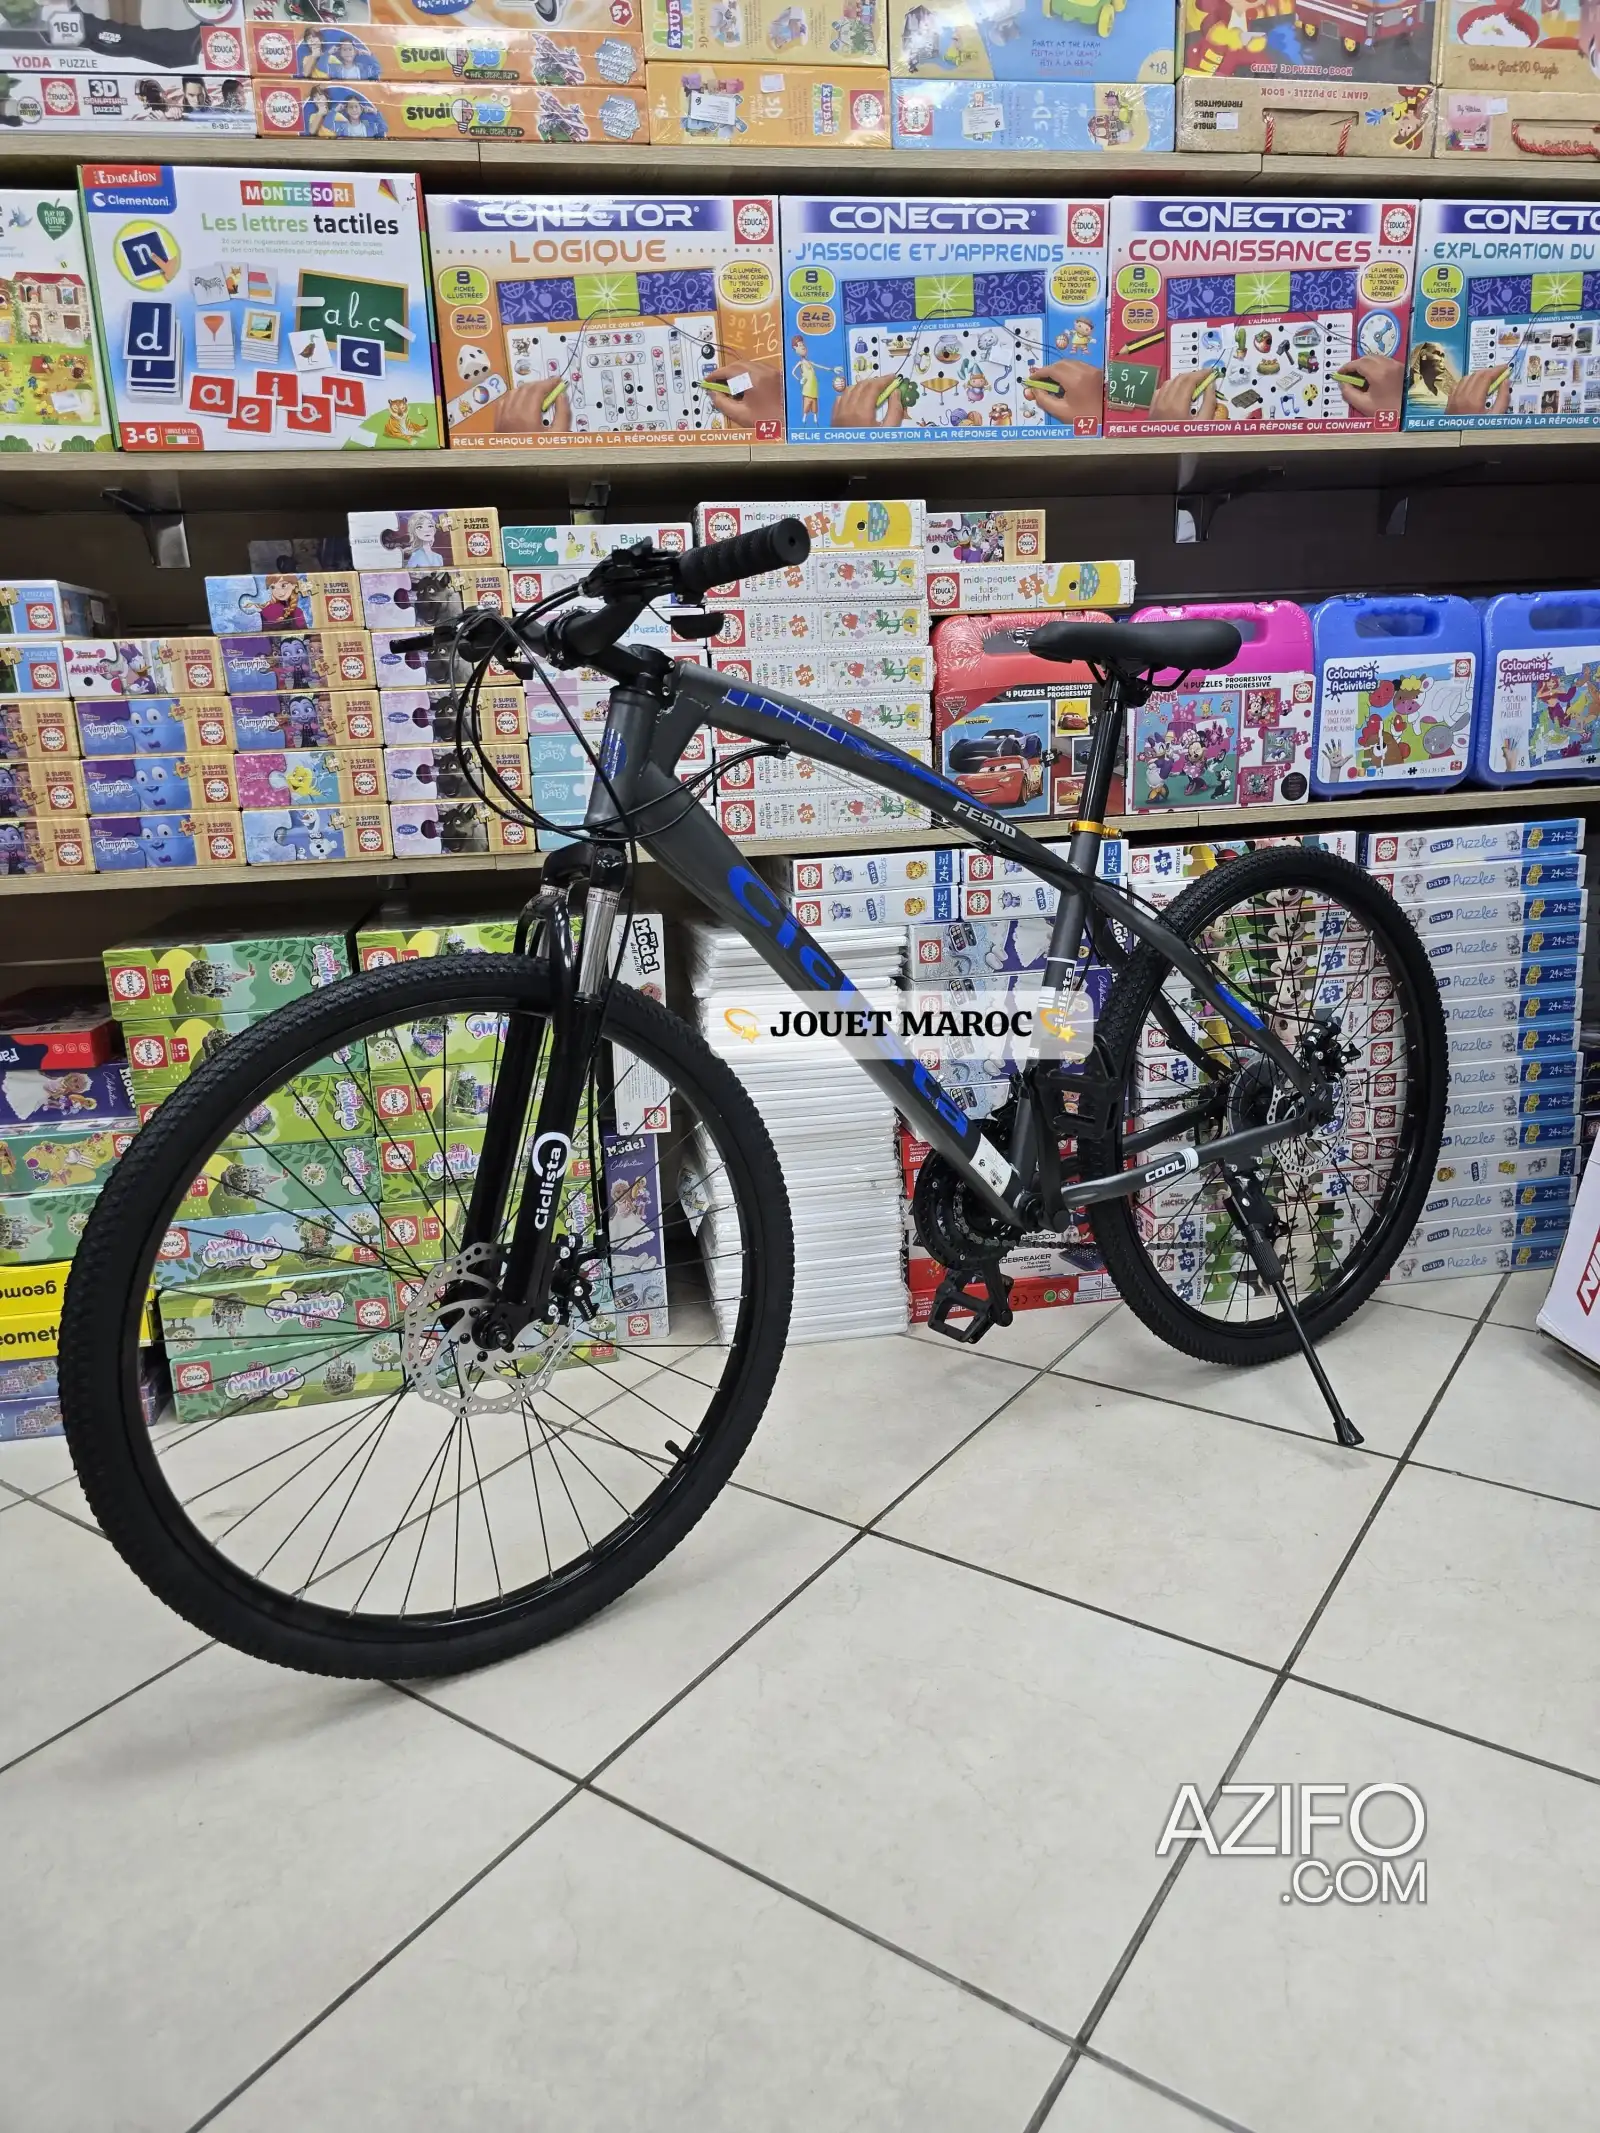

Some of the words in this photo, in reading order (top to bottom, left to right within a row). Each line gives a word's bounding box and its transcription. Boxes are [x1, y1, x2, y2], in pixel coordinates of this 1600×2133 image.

[612, 5, 631, 21] 5+
[53, 21, 79, 33] 160
[12, 55, 51, 69] YODA
[59, 58, 99, 69] PUZZLE
[1251, 63, 1278, 73] GIANT
[1280, 64, 1291, 74] 3D
[1292, 65, 1323, 75] PUZZLE
[1329, 66, 1353, 76] BOOK
[90, 79, 118, 98] 3D
[1260, 87, 1285, 97] BOOK
[1293, 89, 1325, 98] PUZZLE
[1326, 90, 1337, 98] 3D
[1341, 91, 1369, 100] GIANT
[93, 105, 121, 115] puzzle
[245, 185, 350, 202] MONTESSORI
[107, 195, 170, 207] Clementoni
[45, 216, 67, 226] FUTURE
[201, 213, 238, 231] Les
[242, 213, 309, 233] lettres
[313, 213, 399, 235] tactiles
[478, 203, 695, 233] CONECTOR
[743, 218, 765, 226] EDUCA
[829, 205, 1030, 236] CONECTOR
[1159, 205, 1346, 233] CONECTOR
[1389, 221, 1407, 229] EDUCA
[1077, 222, 1095, 230] EDUCA
[509, 239, 667, 267] LOGIQUE
[795, 243, 901, 261] J'ASSOCIE
[909, 243, 937, 261] ET
[938, 243, 1064, 263] J'APPRENDS
[1128, 239, 1372, 262] CONNAISSANCES
[1433, 242, 1564, 260] EXPLORATION
[1570, 243, 1595, 260] DU
[456, 271, 471, 285] 8
[805, 270, 817, 284] 8
[1132, 268, 1146, 281] 8
[1437, 268, 1450, 281] 8
[801, 312, 831, 322] 242
[1127, 308, 1154, 318] 352
[1430, 306, 1456, 316] 352
[456, 313, 486, 324] 242
[751, 311, 777, 336] 12
[1248, 317, 1282, 325] L'ALPHABET
[136, 308, 163, 351] d
[352, 345, 371, 367] c
[1120, 368, 1129, 382] 5
[1138, 371, 1149, 385] 7
[199, 383, 226, 406] a
[270, 377, 283, 402] i
[1108, 381, 1117, 394] 9
[1124, 385, 1135, 399] 11
[331, 384, 355, 409] u
[239, 405, 261, 425] e
[1379, 411, 1395, 423] 5-8
[759, 422, 777, 433] 4-7
[1077, 417, 1095, 430] 4-7
[1109, 423, 1138, 434] RELIE
[1140, 422, 1182, 433] CHAQUE
[1183, 422, 1233, 433] QUESTION
[1235, 420, 1242, 431] À
[1244, 422, 1258, 432] LA
[1259, 420, 1305, 431] RÉPONSE
[1307, 421, 1324, 431] QUI
[1325, 420, 1372, 430] CONVIENT
[125, 427, 158, 444] 3-6
[453, 436, 486, 447] RELIE
[488, 435, 533, 447] CHAQUE
[537, 434, 593, 446] QUESTION
[595, 431, 603, 443] À
[605, 433, 622, 443] LA
[624, 431, 676, 443] RÉPONSE
[678, 432, 697, 443] QUI
[700, 432, 753, 442] CONVIENT
[791, 431, 821, 441] RELIE
[824, 430, 867, 440] CHAQUE
[869, 429, 923, 440] QUESTION
[925, 427, 933, 438] À
[933, 429, 949, 439] LA
[950, 427, 999, 439] RÉPONSE
[1000, 428, 1019, 438] QUI
[1020, 428, 1071, 437] CONVIENT
[463, 522, 490, 531] PUZZLES
[714, 523, 730, 532] EDUCA
[518, 548, 535, 556] baby
[963, 575, 1017, 586] mide-peques
[964, 593, 991, 603] height
[992, 593, 1014, 601] chart
[633, 624, 669, 634] Puzzles
[1500, 660, 1548, 672] Colouring
[1327, 668, 1374, 681] Colouring
[1504, 671, 1550, 682] Activities
[1190, 679, 1223, 689] PUZZLES
[1225, 675, 1272, 683] PROGRESIVOS
[1225, 681, 1271, 689] PROGRESSIVE
[1331, 681, 1377, 691] Activities
[1006, 690, 1012, 698] 4
[1013, 689, 1046, 698] PUZZLES
[1046, 684, 1093, 692] PROGRESIVOS
[1047, 690, 1092, 698] PROGRESSIVE
[1046, 753, 1054, 761] 25
[1430, 839, 1453, 853] baby
[1456, 836, 1498, 849] Puzzles
[1551, 833, 1565, 842] 24+
[1429, 911, 1453, 923] baby
[1456, 907, 1498, 920] Puzzles
[633, 917, 660, 975] Model
[650, 932, 658, 947] my
[159, 974, 170, 990] 6+
[1144, 1160, 1185, 1183] COOL
[534, 1147, 562, 1230] Ciclista
[205, 1239, 276, 1261] Gardens
[227, 1369, 297, 1394] Gardens
